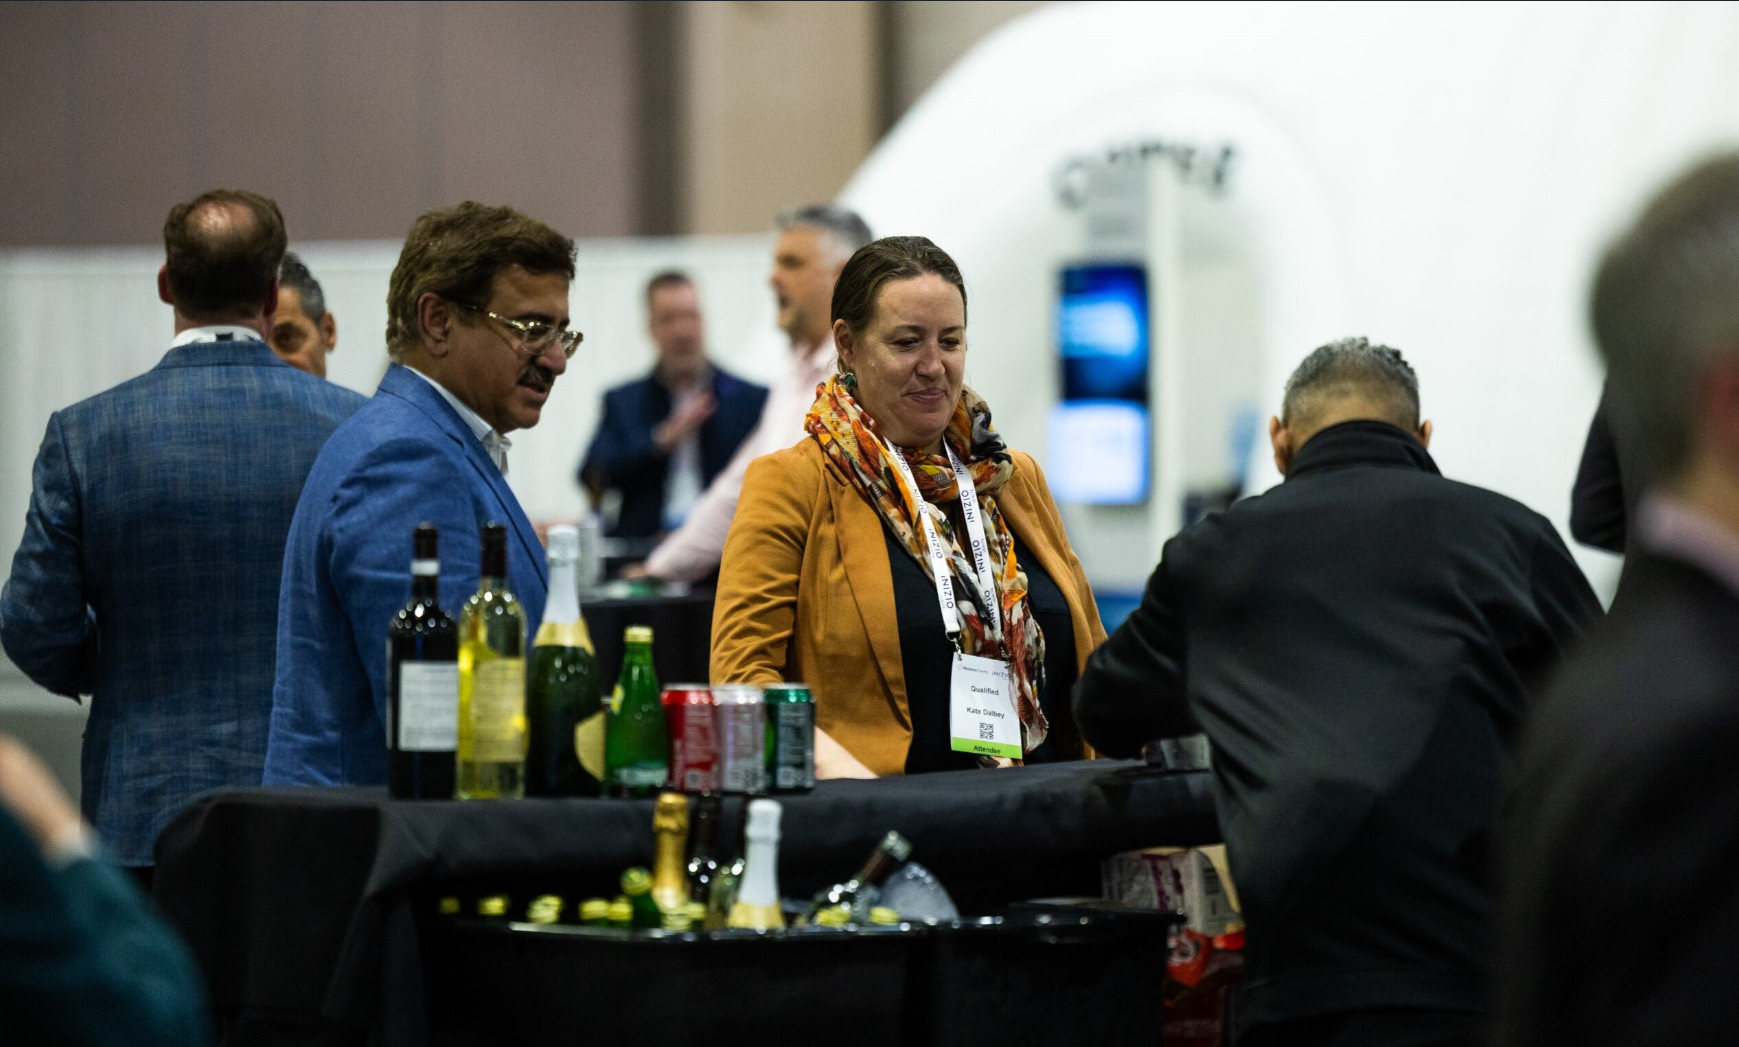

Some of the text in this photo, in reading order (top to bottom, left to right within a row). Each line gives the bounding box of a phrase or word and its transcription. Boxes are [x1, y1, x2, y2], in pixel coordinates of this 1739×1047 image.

[961, 489, 975, 523] INIZIO
[928, 528, 943, 559] INIZIO
[972, 540, 986, 573] INIZIO
[940, 575, 954, 609] INIZIO
[970, 685, 999, 696] Qualified
[966, 707, 1005, 719] Kate Dalbey
